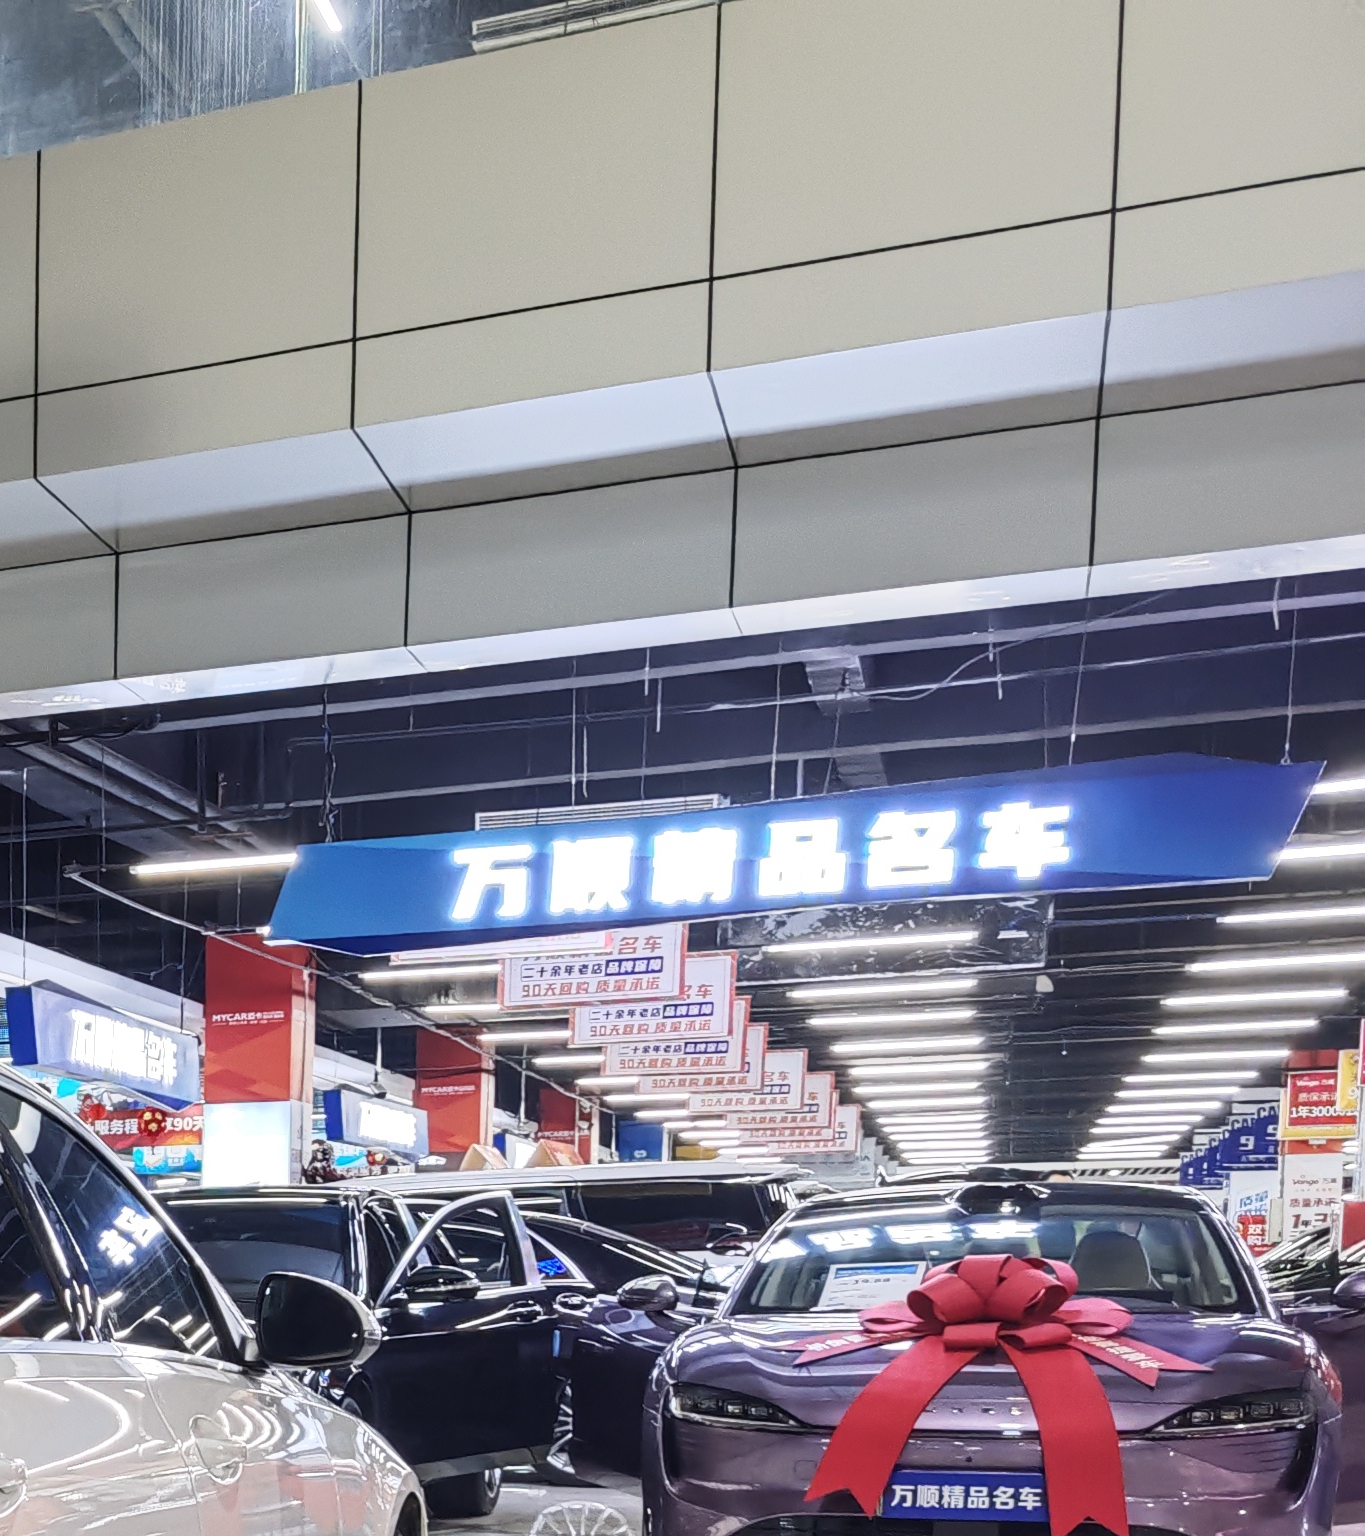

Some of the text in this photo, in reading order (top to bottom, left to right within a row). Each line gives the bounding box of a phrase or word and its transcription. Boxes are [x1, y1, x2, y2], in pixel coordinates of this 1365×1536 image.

[450, 802, 1073, 922] 万顺精品名车
[890, 1484, 1043, 1512] 万顺精品名车
